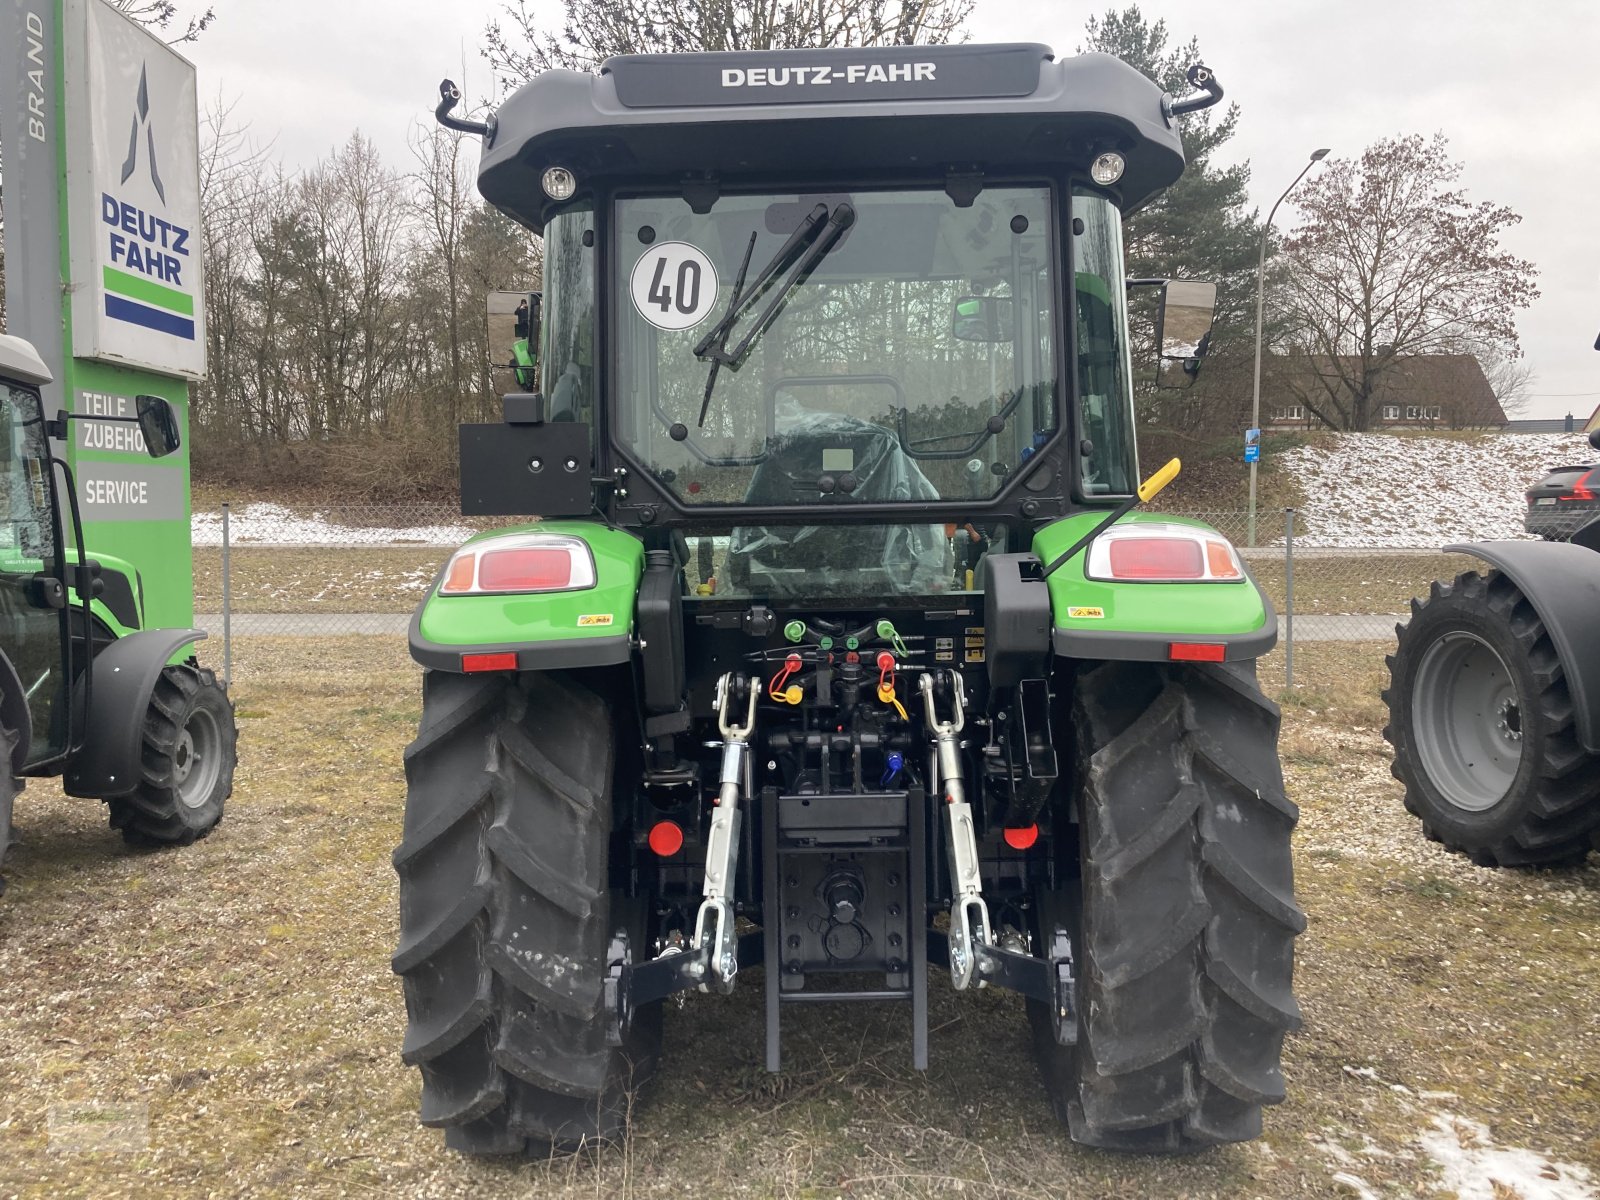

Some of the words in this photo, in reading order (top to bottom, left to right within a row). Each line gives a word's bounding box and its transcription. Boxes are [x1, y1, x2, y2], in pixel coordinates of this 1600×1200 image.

[26, 11, 46, 142] BRAND
[721, 62, 937, 87] DEUTZ-FAHR
[102, 191, 189, 257] DEUTZ
[110, 232, 182, 287] FAHR
[648, 257, 701, 314] 40
[84, 423, 149, 453] ZUBEHÖ
[86, 480, 148, 504] SERVICE
